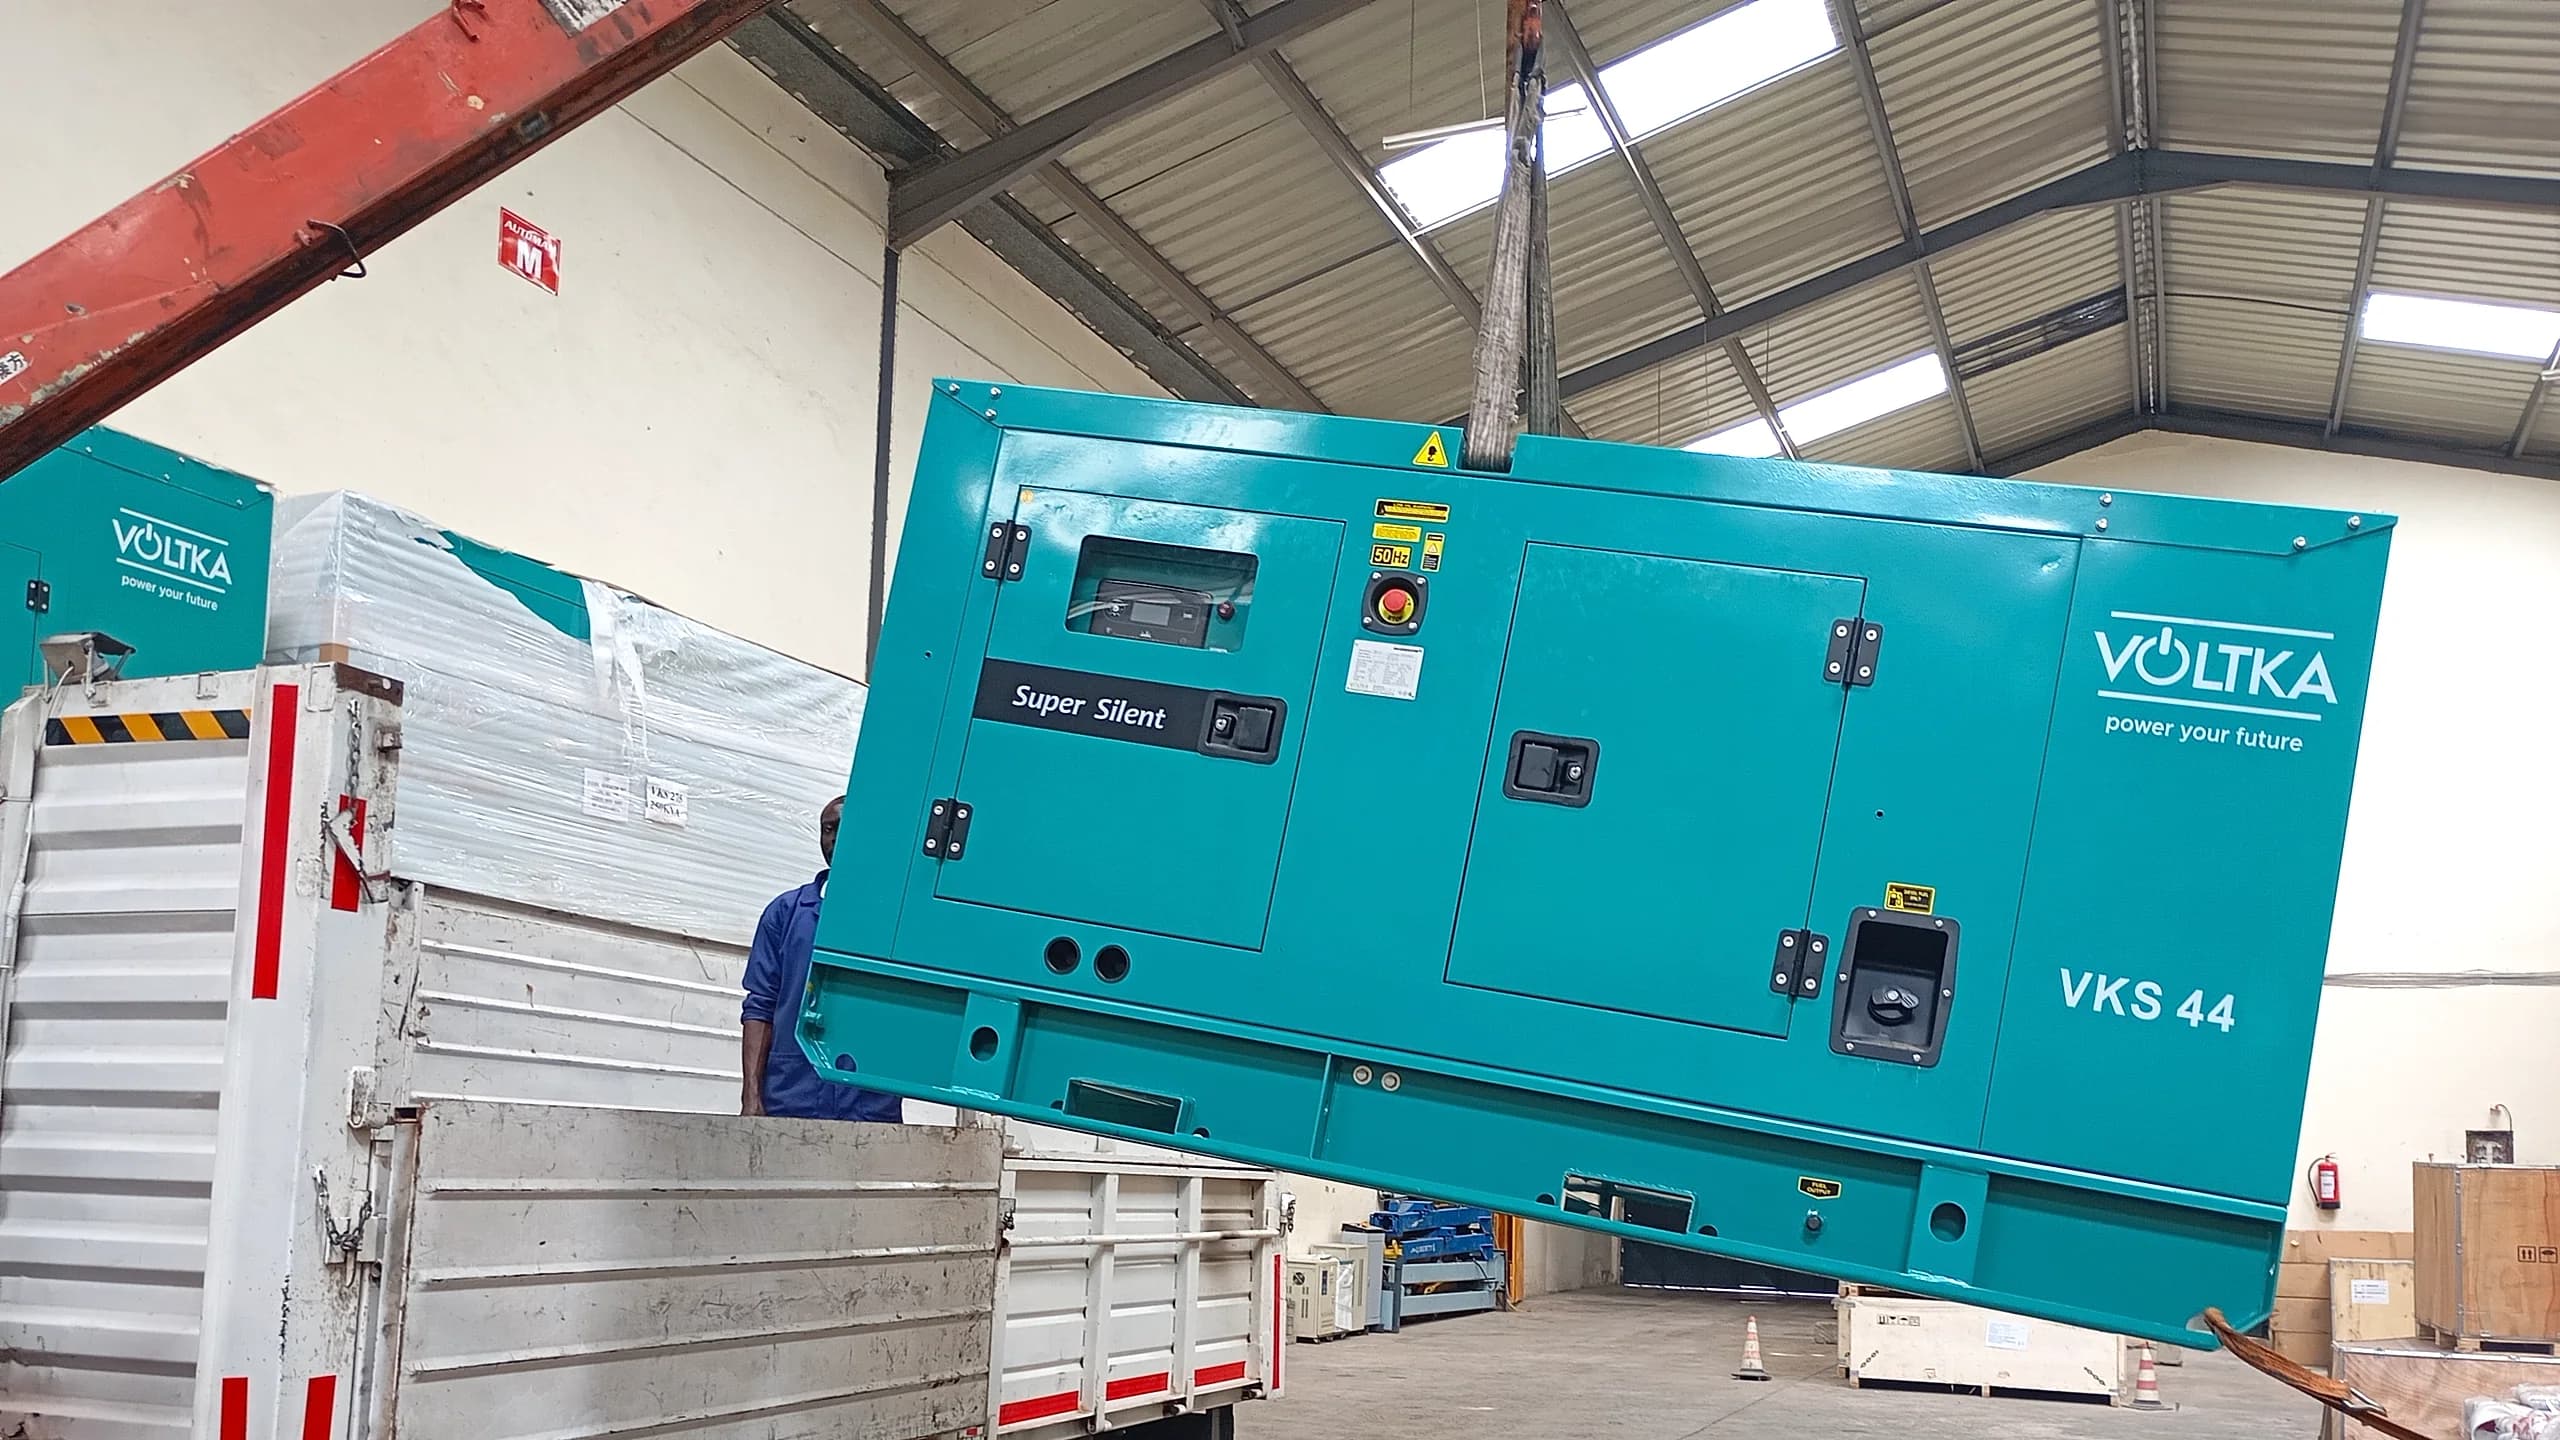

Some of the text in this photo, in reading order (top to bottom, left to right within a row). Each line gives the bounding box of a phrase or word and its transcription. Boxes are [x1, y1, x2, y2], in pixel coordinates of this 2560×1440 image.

[516, 239, 543, 280] M
[112, 518, 233, 585] VOLTKA
[121, 575, 219, 611] power your future
[2094, 626, 2339, 705] VOLTKA
[1011, 684, 1168, 730] Super Silent
[2105, 715, 2304, 753] power your future
[2060, 967, 2236, 1033] VKS 44
